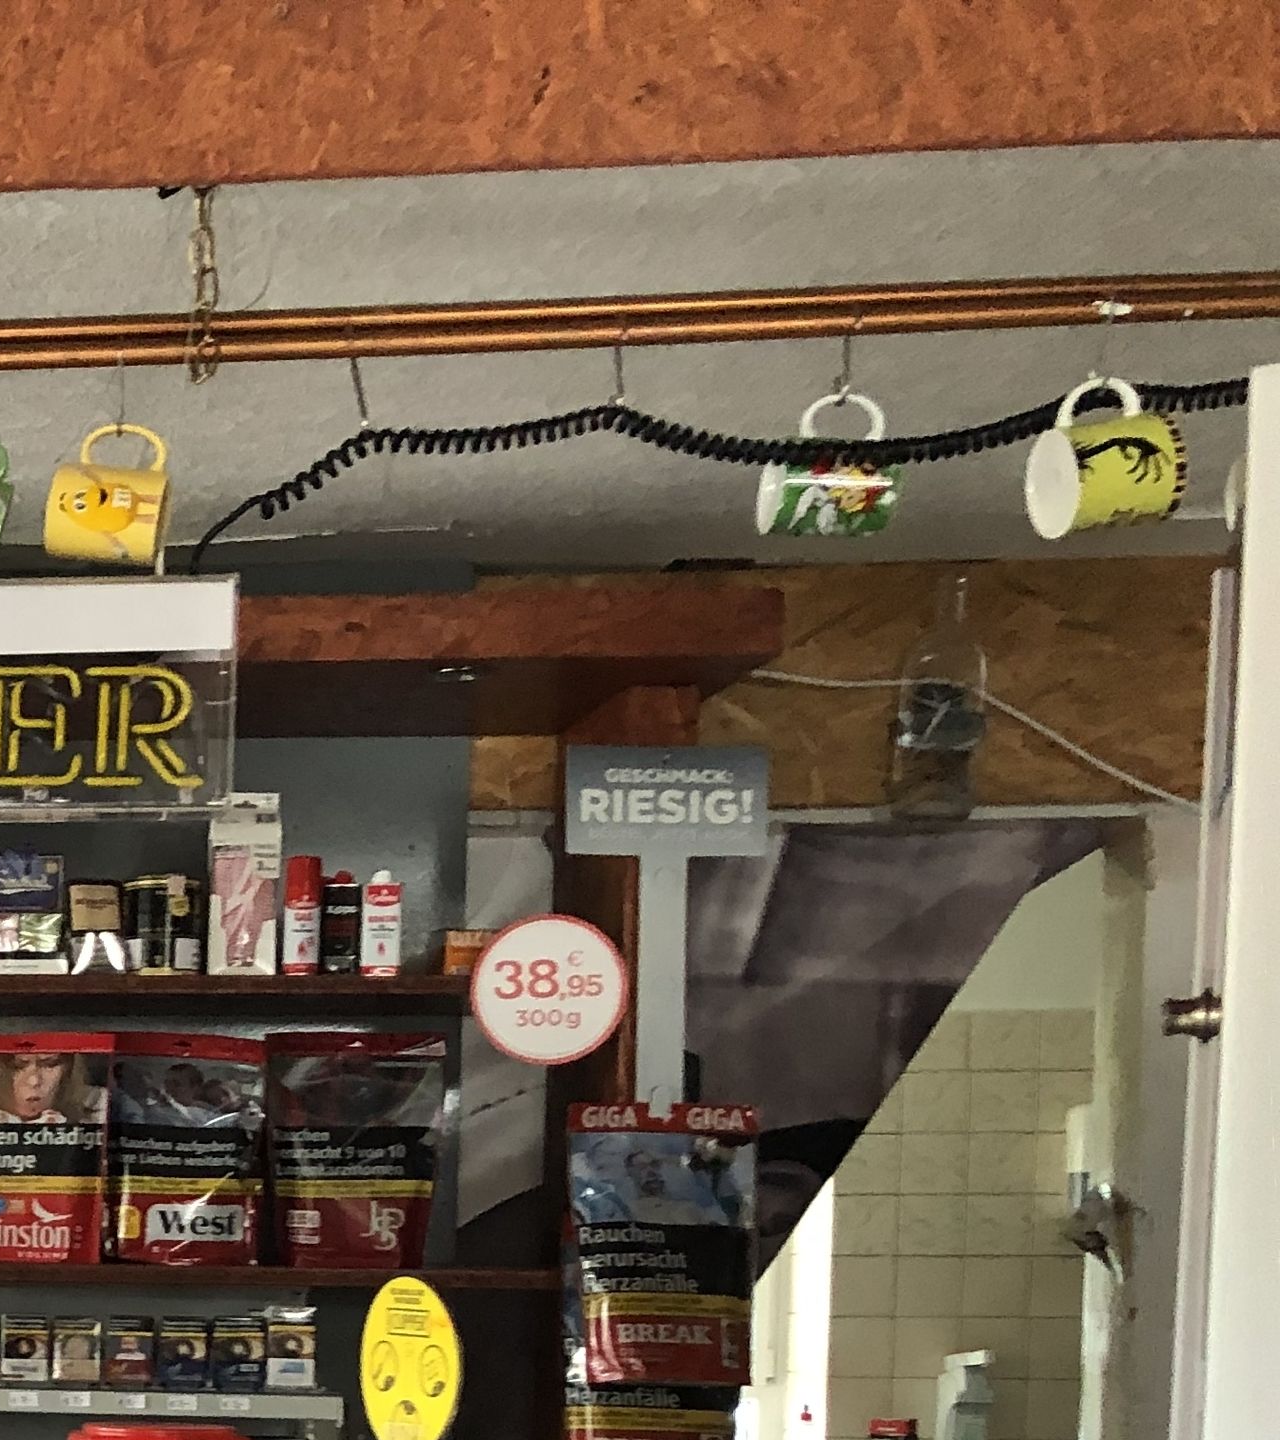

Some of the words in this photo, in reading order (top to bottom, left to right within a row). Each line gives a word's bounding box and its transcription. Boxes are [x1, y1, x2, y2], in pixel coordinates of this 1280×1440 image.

[579, 788, 755, 825] RIESIG!
[582, 1106, 639, 1129] GIGA
[685, 1107, 746, 1131] GIGA
[23, 1126, 104, 1148] schädigt
[157, 1209, 238, 1236] West
[579, 1224, 665, 1245] Rauchen
[617, 1322, 713, 1346] BREAK
